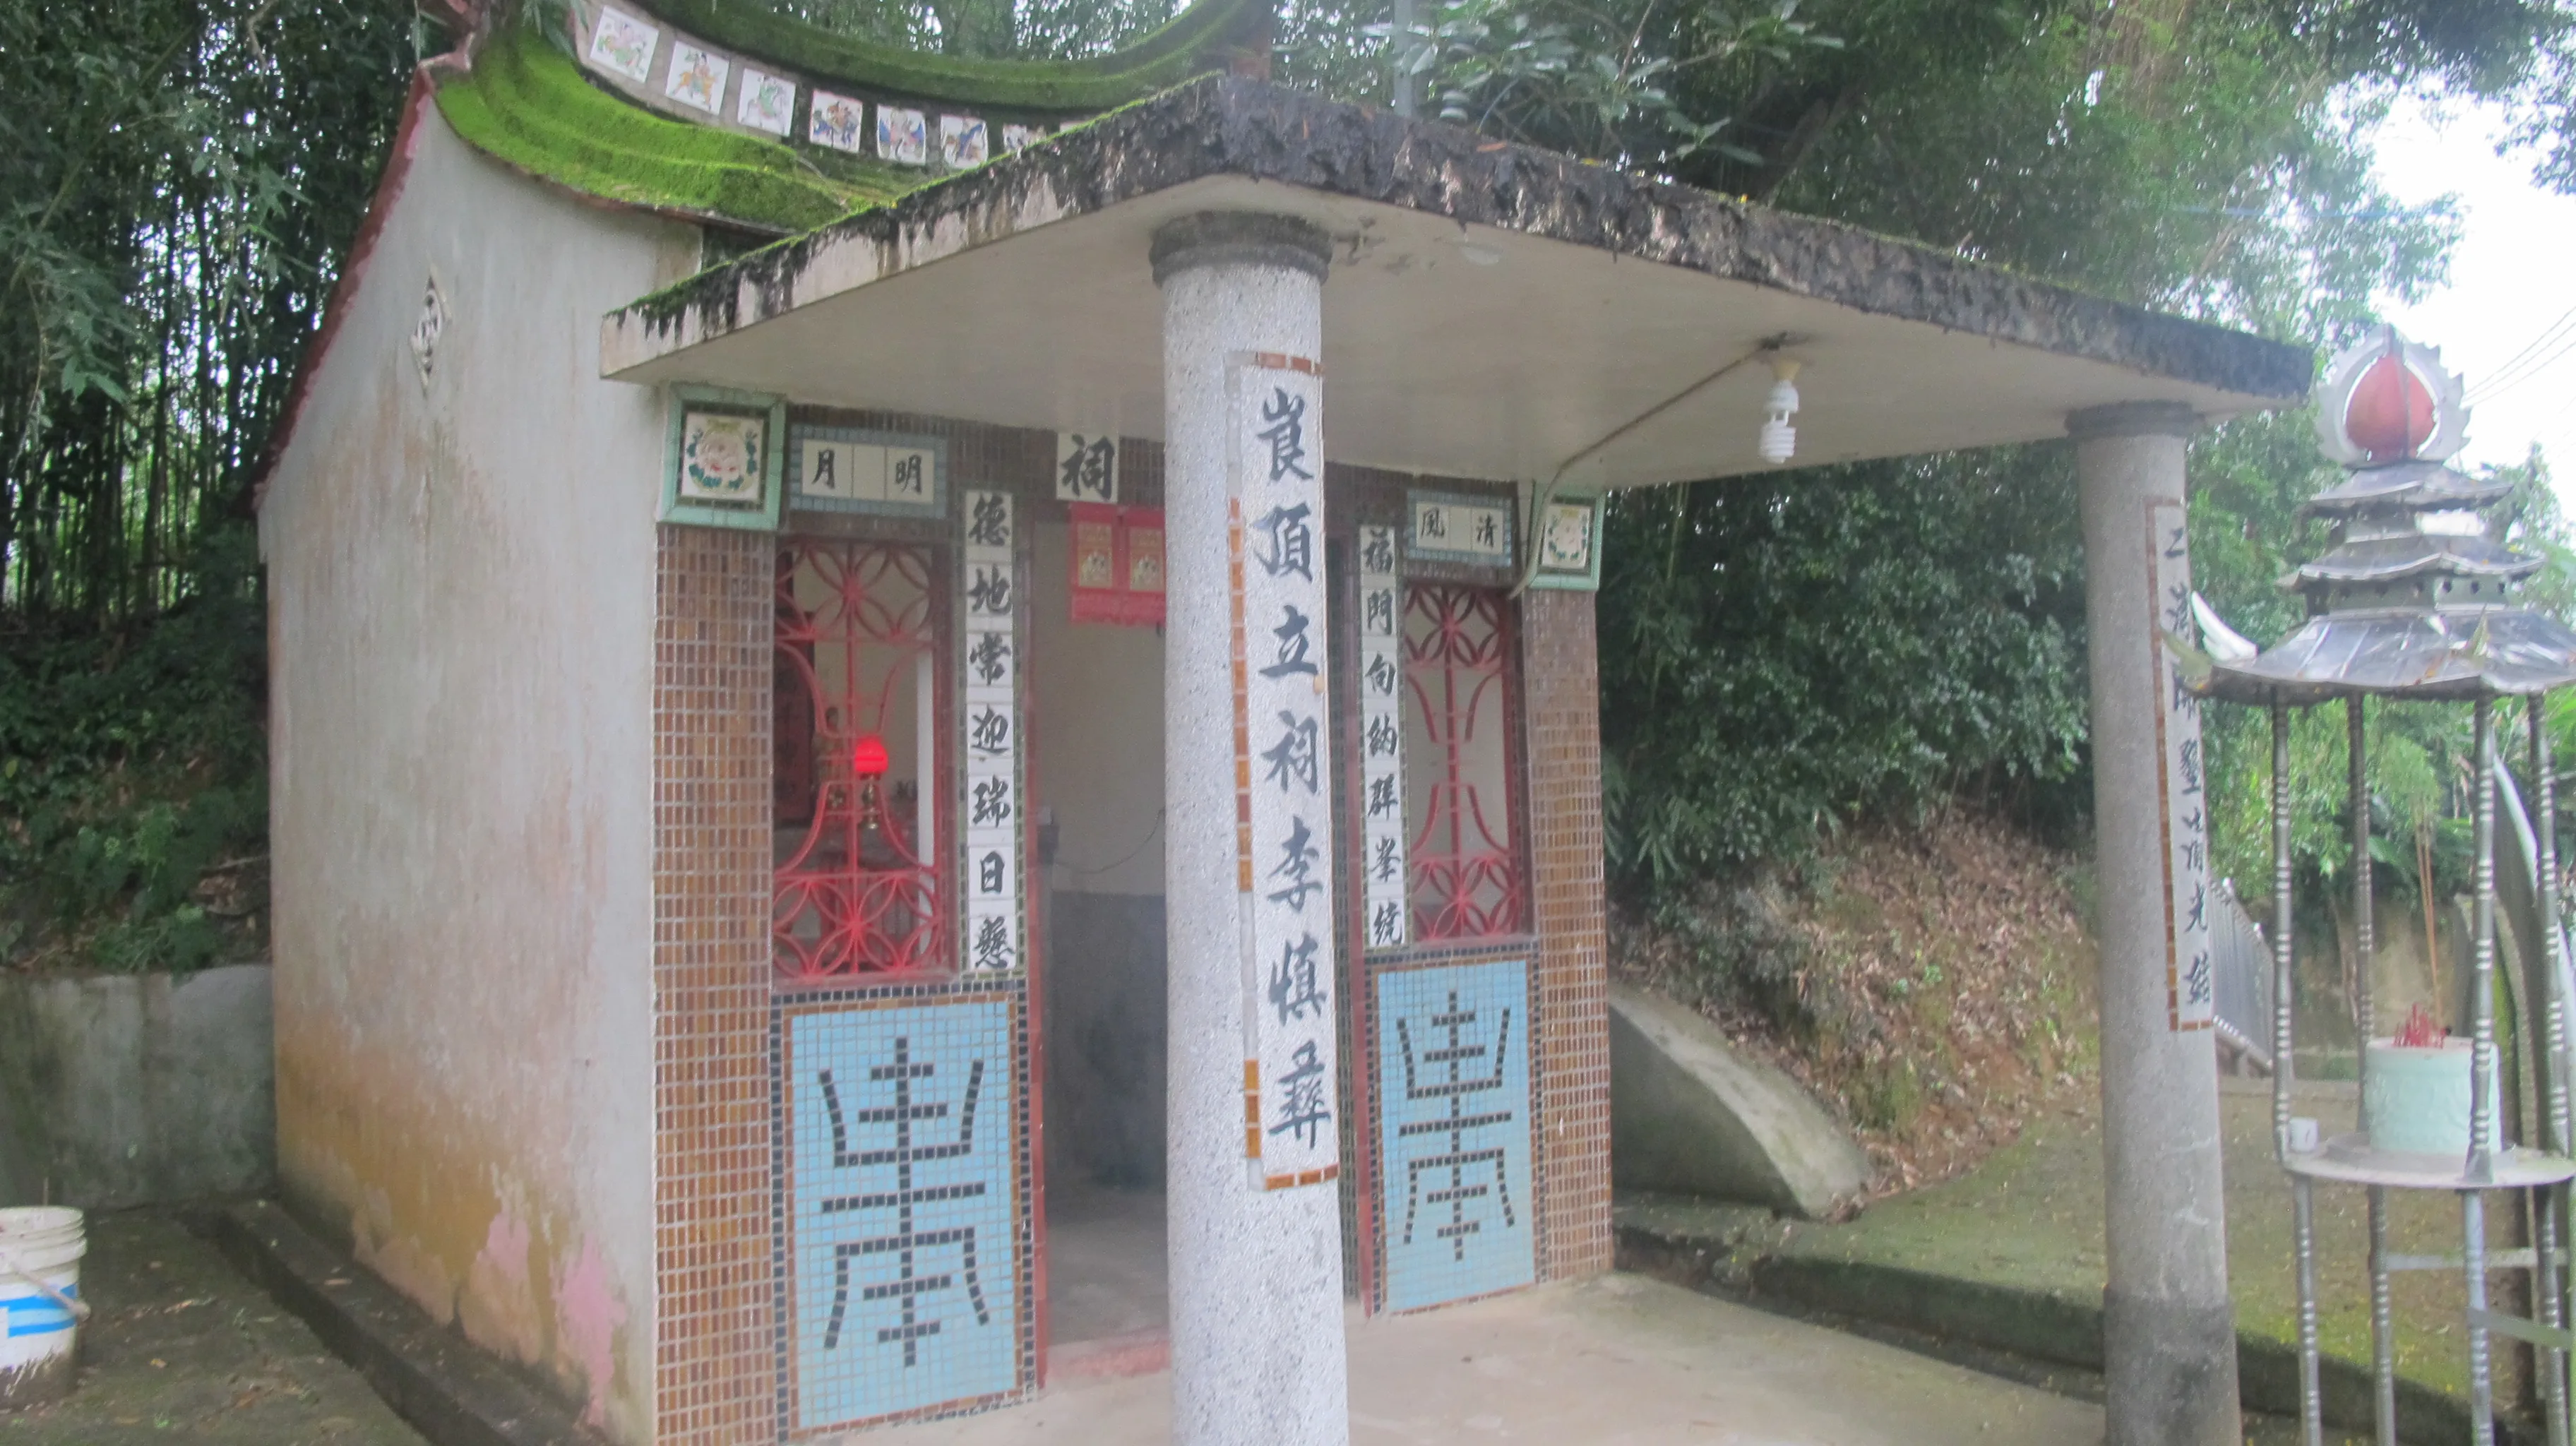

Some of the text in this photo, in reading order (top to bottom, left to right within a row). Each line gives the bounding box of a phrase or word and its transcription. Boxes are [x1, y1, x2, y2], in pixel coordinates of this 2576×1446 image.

[1059, 433, 1116, 500] 祠
[967, 492, 1014, 969] 德地常迎瑞日懸
